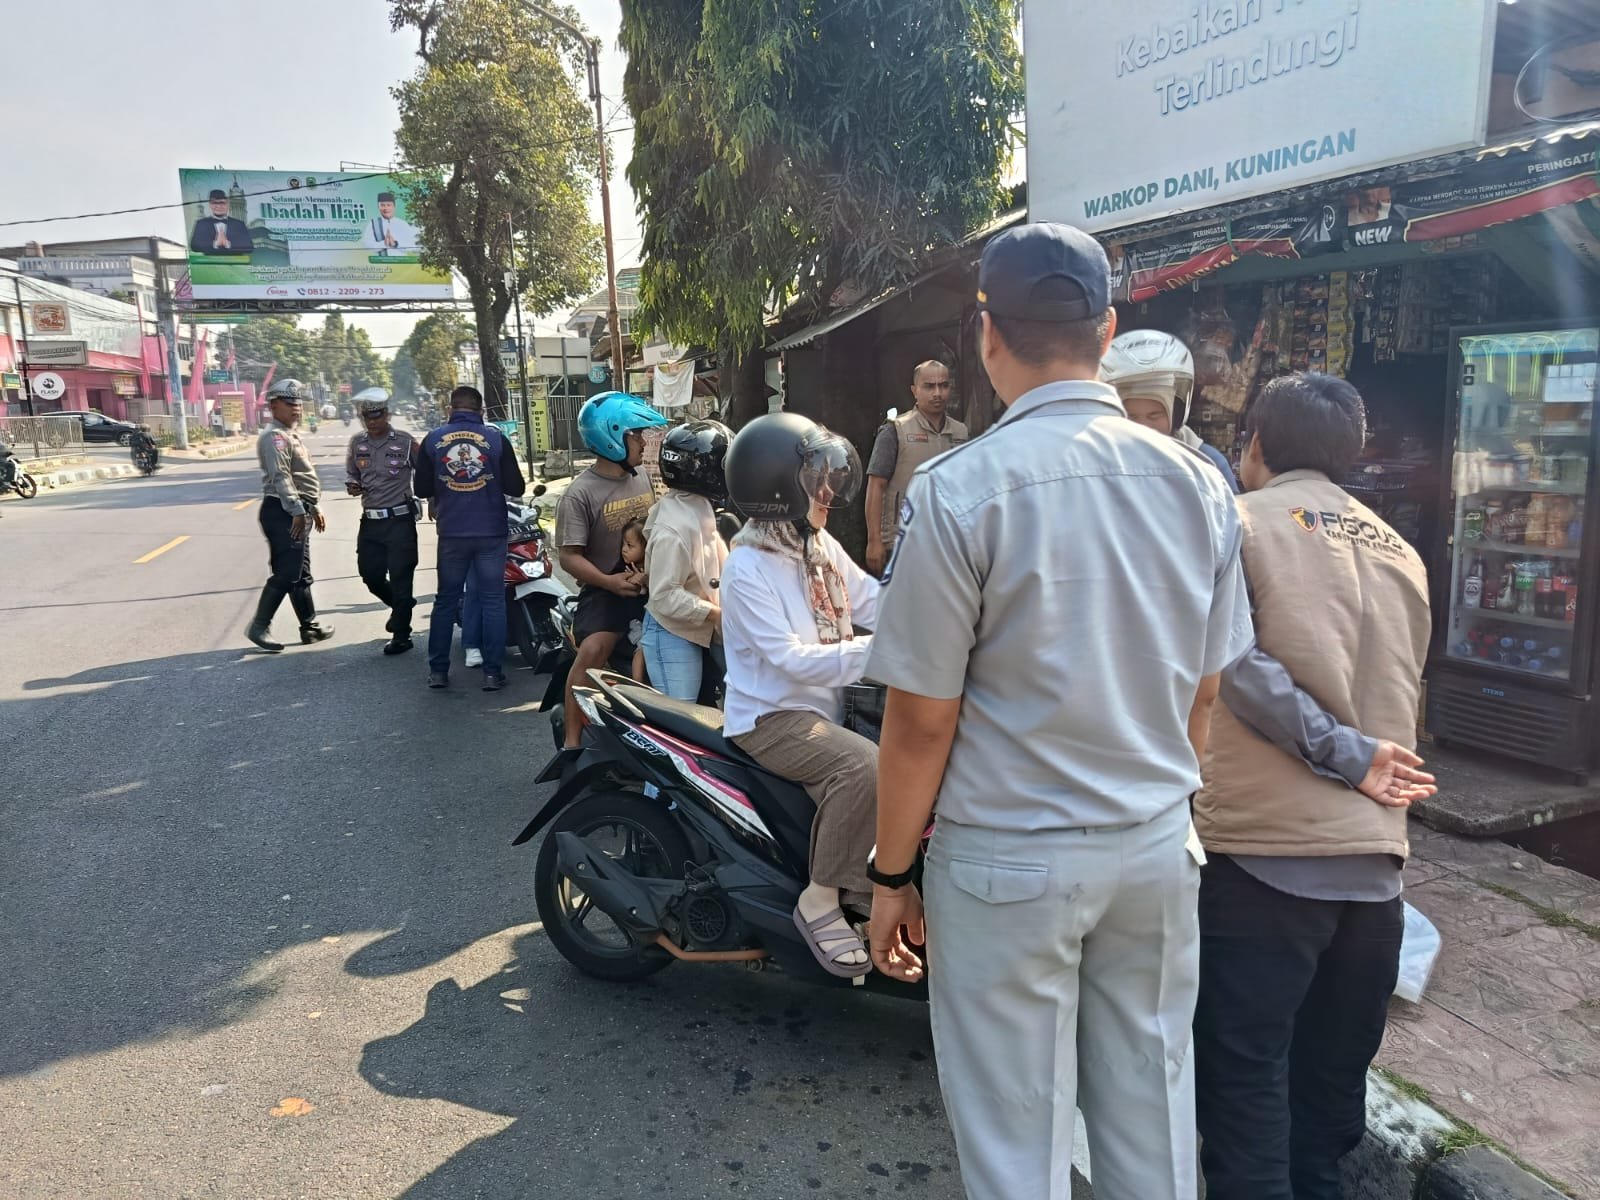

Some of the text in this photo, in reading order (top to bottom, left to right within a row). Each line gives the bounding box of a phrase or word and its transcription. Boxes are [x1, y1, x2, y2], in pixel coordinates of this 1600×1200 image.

[1116, 0, 1261, 77] Kebaikan
[1155, 9, 1360, 115] Terlindungi
[1084, 128, 1356, 218] WARKOP DANI, KUNINGAN
[1528, 151, 1596, 174] PERINGATA
[261, 202, 366, 224] Ibadah Haji
[1355, 225, 1393, 247] NEW
[307, 287, 329, 295] 0812
[338, 287, 360, 295] 2209
[368, 287, 385, 295] 273
[758, 503, 790, 513] JPN
[1319, 511, 1403, 550] FISCUS
